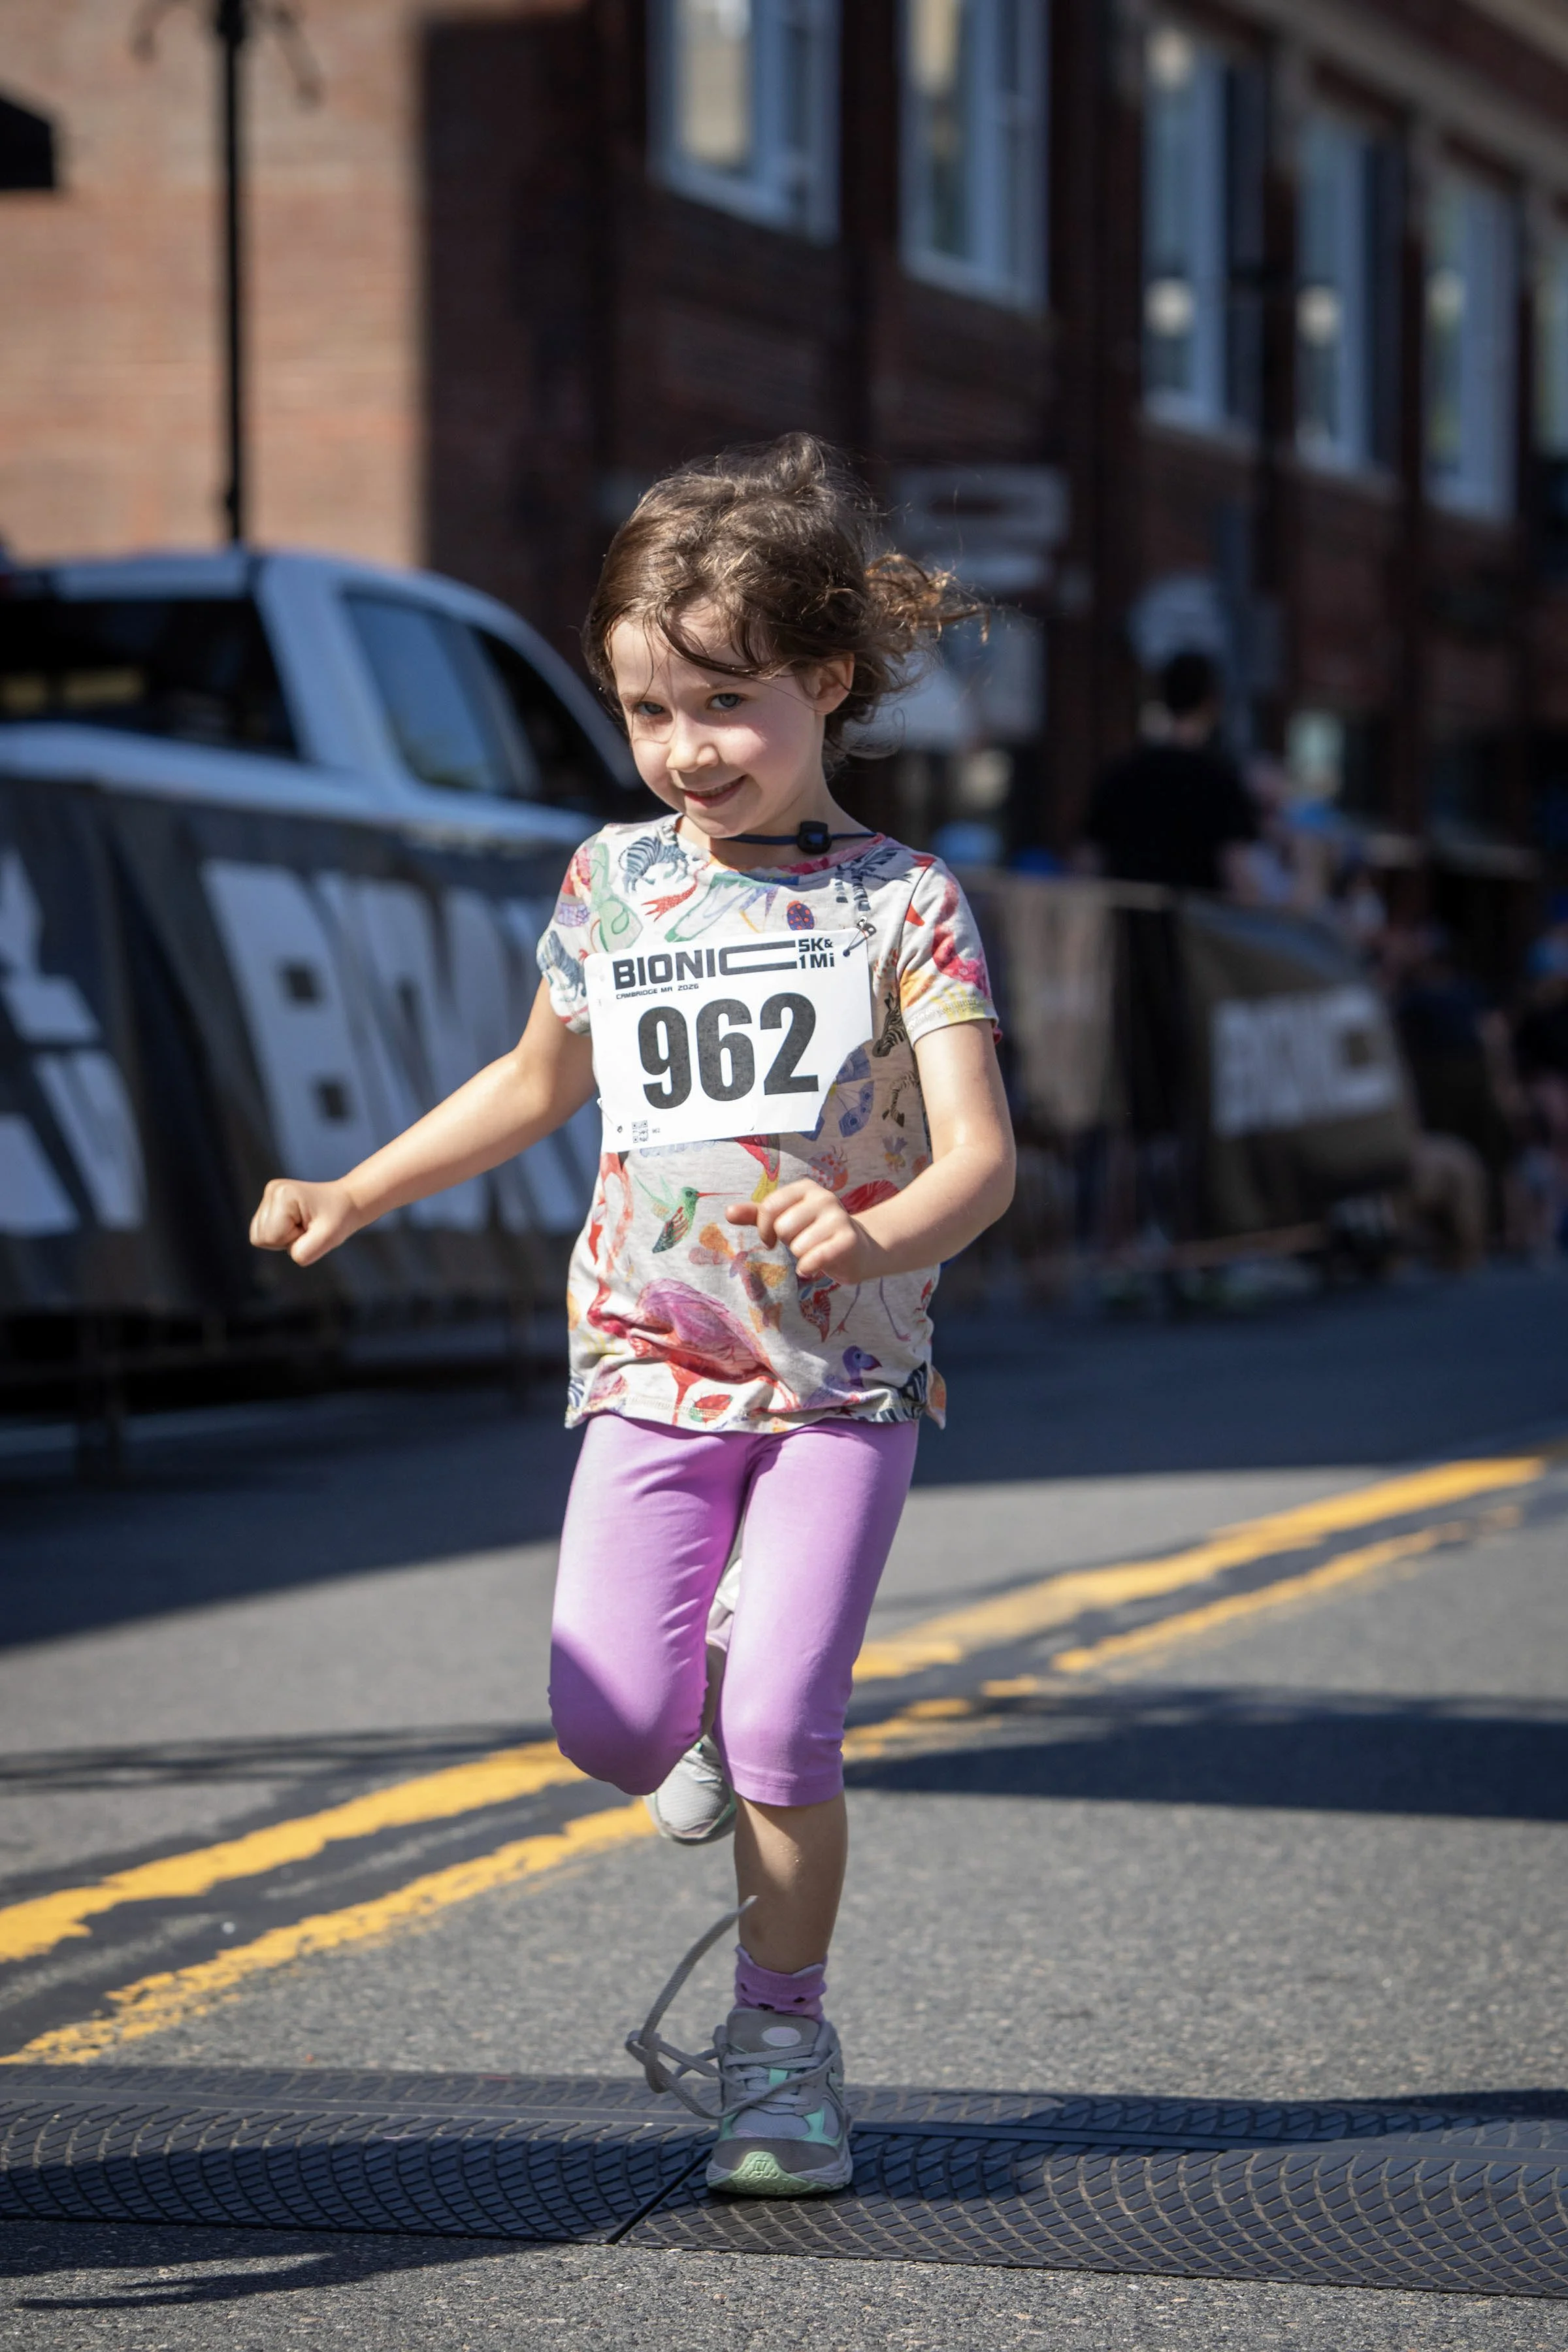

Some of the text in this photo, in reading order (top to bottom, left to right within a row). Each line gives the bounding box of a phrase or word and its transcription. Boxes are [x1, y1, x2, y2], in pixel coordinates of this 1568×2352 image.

[613, 940, 797, 990] BIONIC
[799, 953, 834, 969] 1 Mi
[615, 988, 658, 1000] CAMBRIDGE
[638, 992, 819, 1109] 962
